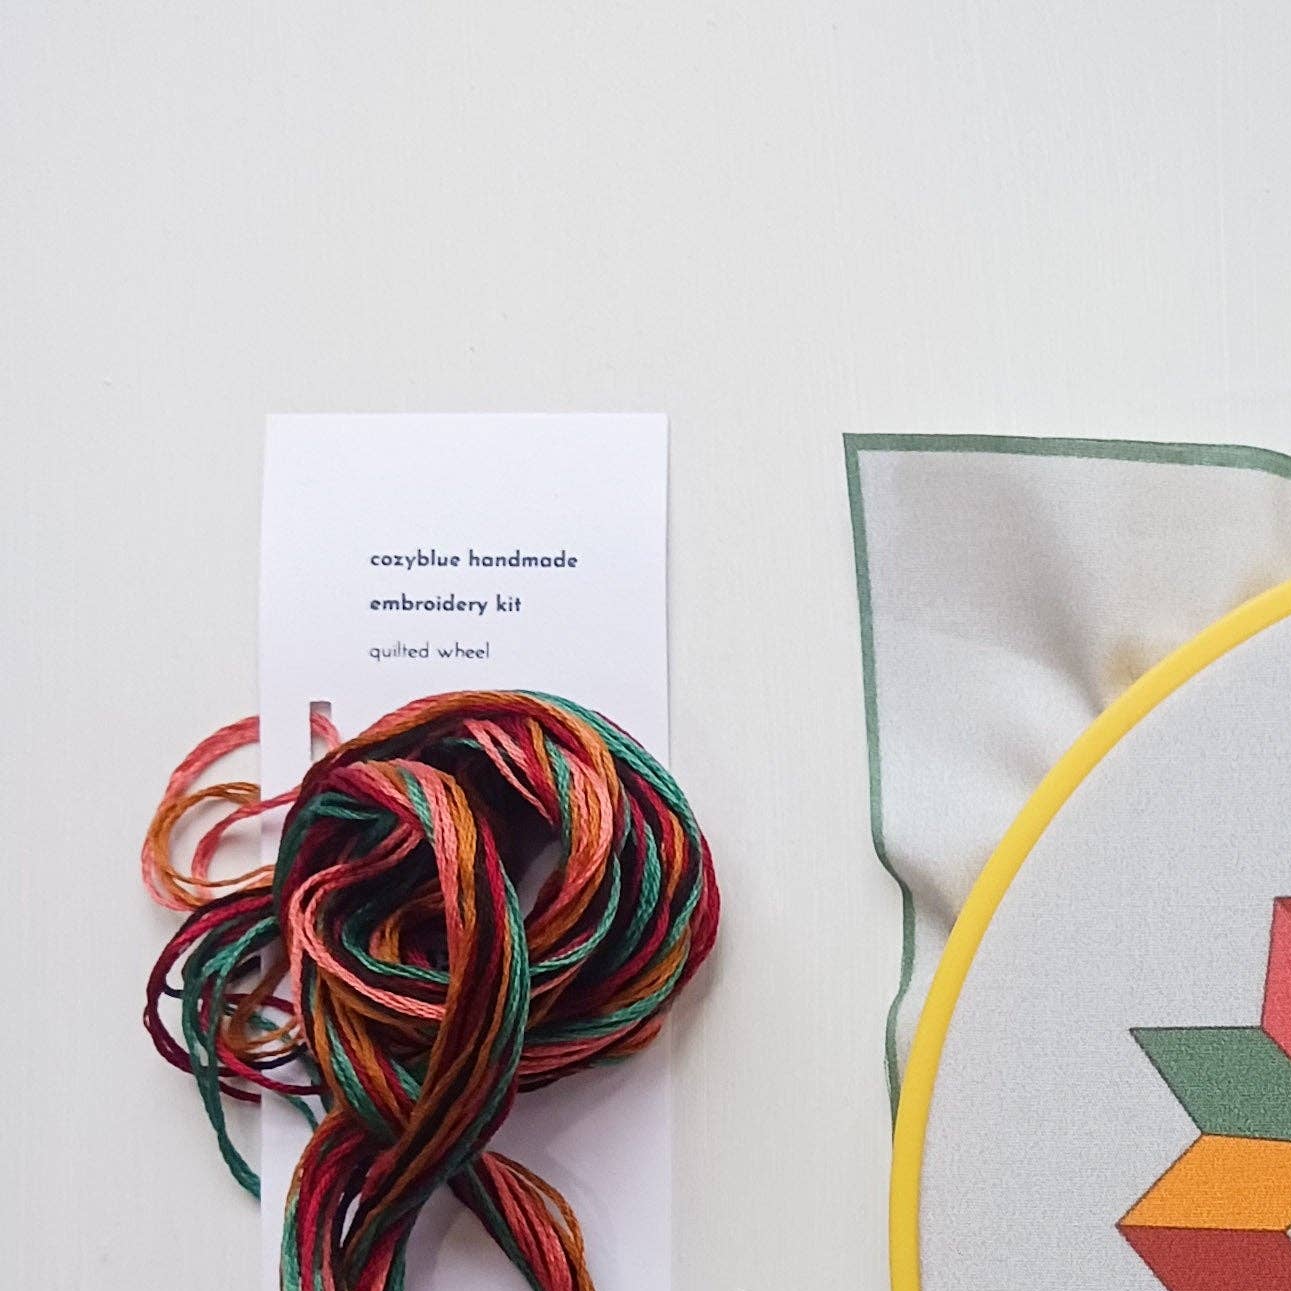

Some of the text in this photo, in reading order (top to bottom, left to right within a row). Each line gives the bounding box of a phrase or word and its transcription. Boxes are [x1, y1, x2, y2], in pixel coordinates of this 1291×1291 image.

[370, 549, 578, 571] cozyblue handmade
[369, 593, 521, 616] embroidery kit
[369, 641, 490, 661] quilted wheel
